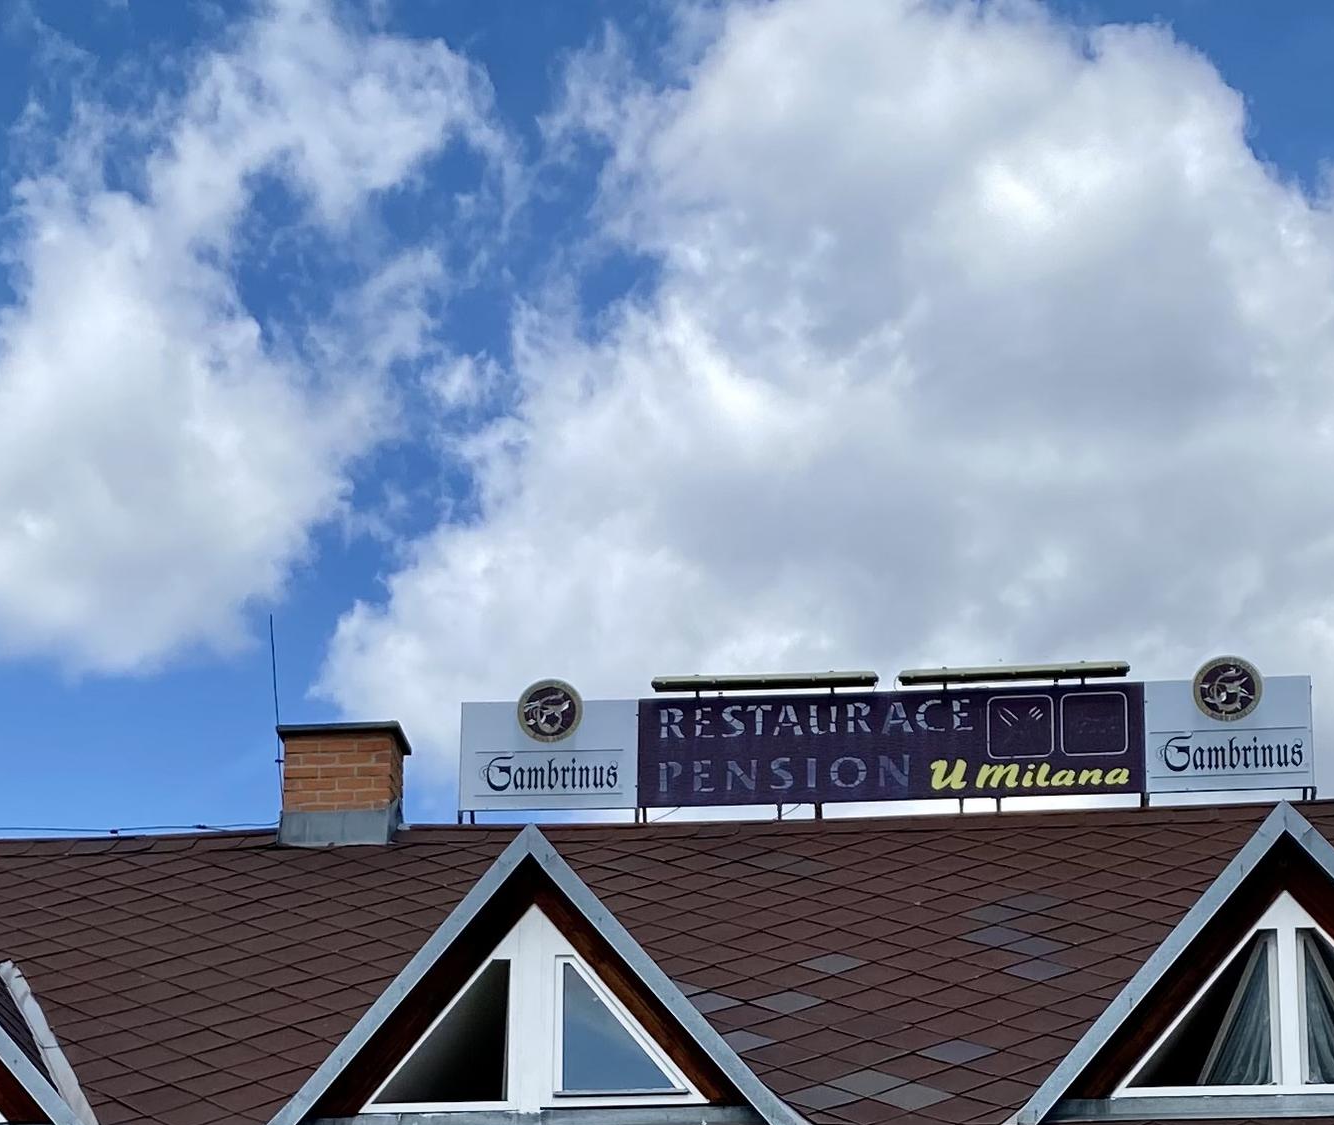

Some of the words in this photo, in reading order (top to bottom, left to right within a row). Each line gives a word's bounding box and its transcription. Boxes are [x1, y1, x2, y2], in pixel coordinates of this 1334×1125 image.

[658, 698, 974, 739] RESTAURACE
[1156, 732, 1304, 772] Gambrinus
[480, 753, 619, 792] Gambrinus
[658, 754, 911, 793] PENSION
[975, 762, 1130, 789] Milana
